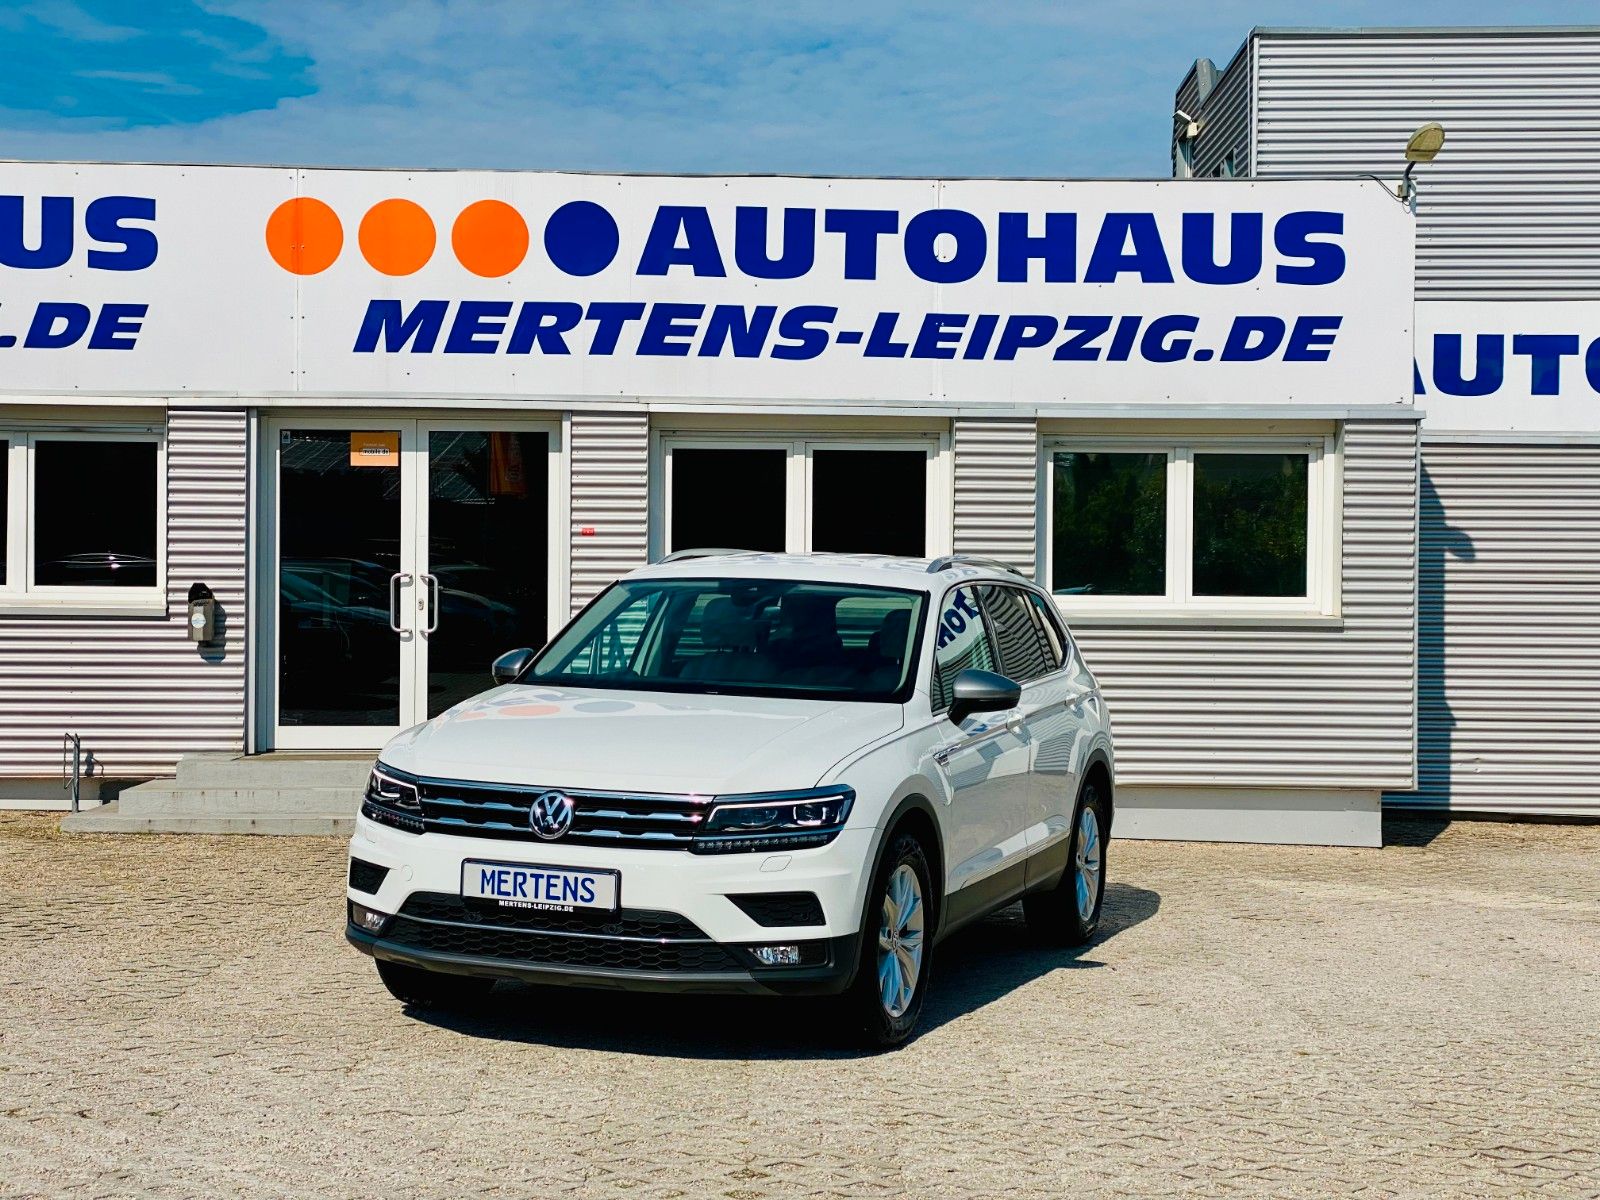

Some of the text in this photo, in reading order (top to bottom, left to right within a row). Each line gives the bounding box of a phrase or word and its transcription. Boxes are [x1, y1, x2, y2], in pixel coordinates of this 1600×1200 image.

[637, 206, 1346, 285] AUTOHAUS
[354, 299, 1342, 362] MERTENS-LEIPZIG.DE
[1414, 333, 1600, 396] UT
[481, 869, 595, 903] MERTENS
[499, 900, 574, 912] MERTENS-LEIPZIG.DE
